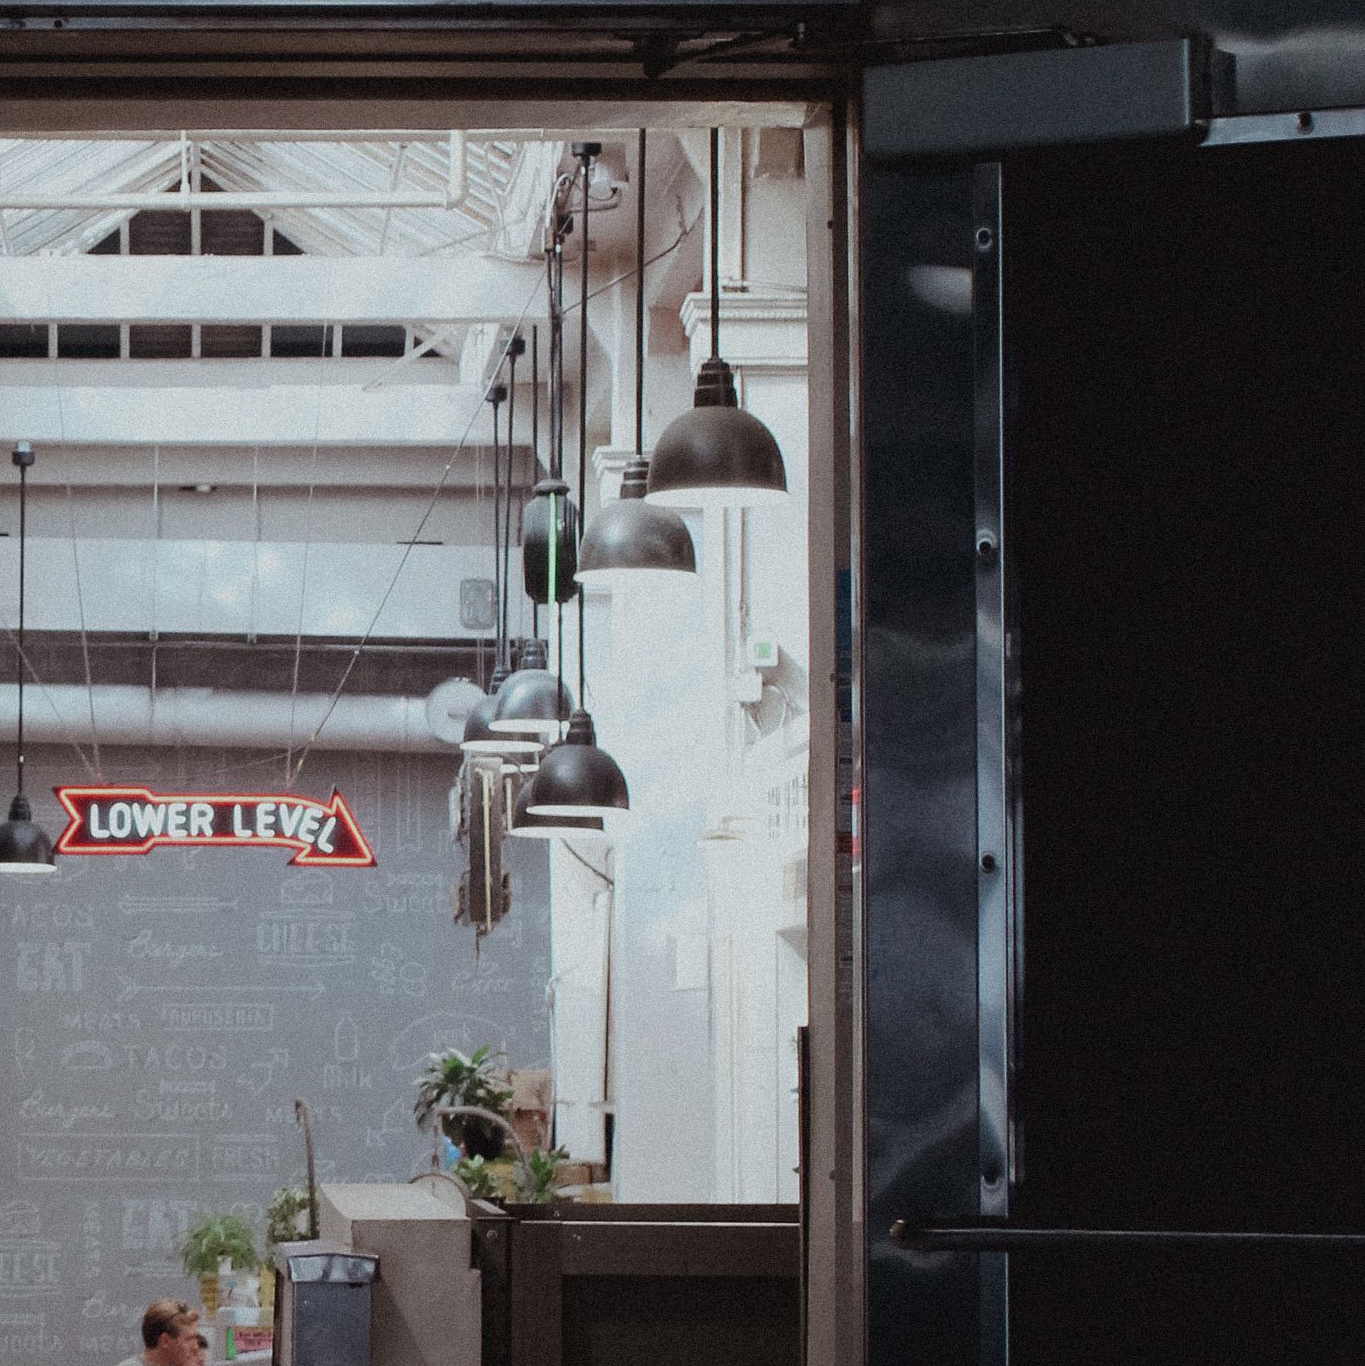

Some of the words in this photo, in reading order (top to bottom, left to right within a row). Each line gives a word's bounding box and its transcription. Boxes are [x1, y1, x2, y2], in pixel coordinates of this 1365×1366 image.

[89, 801, 215, 840] LOWER
[233, 802, 338, 854] LEVEL
[256, 921, 355, 953] CHEESE
[123, 1045, 229, 1071] TACOS
[28, 1147, 192, 1170] VEGETABLES
